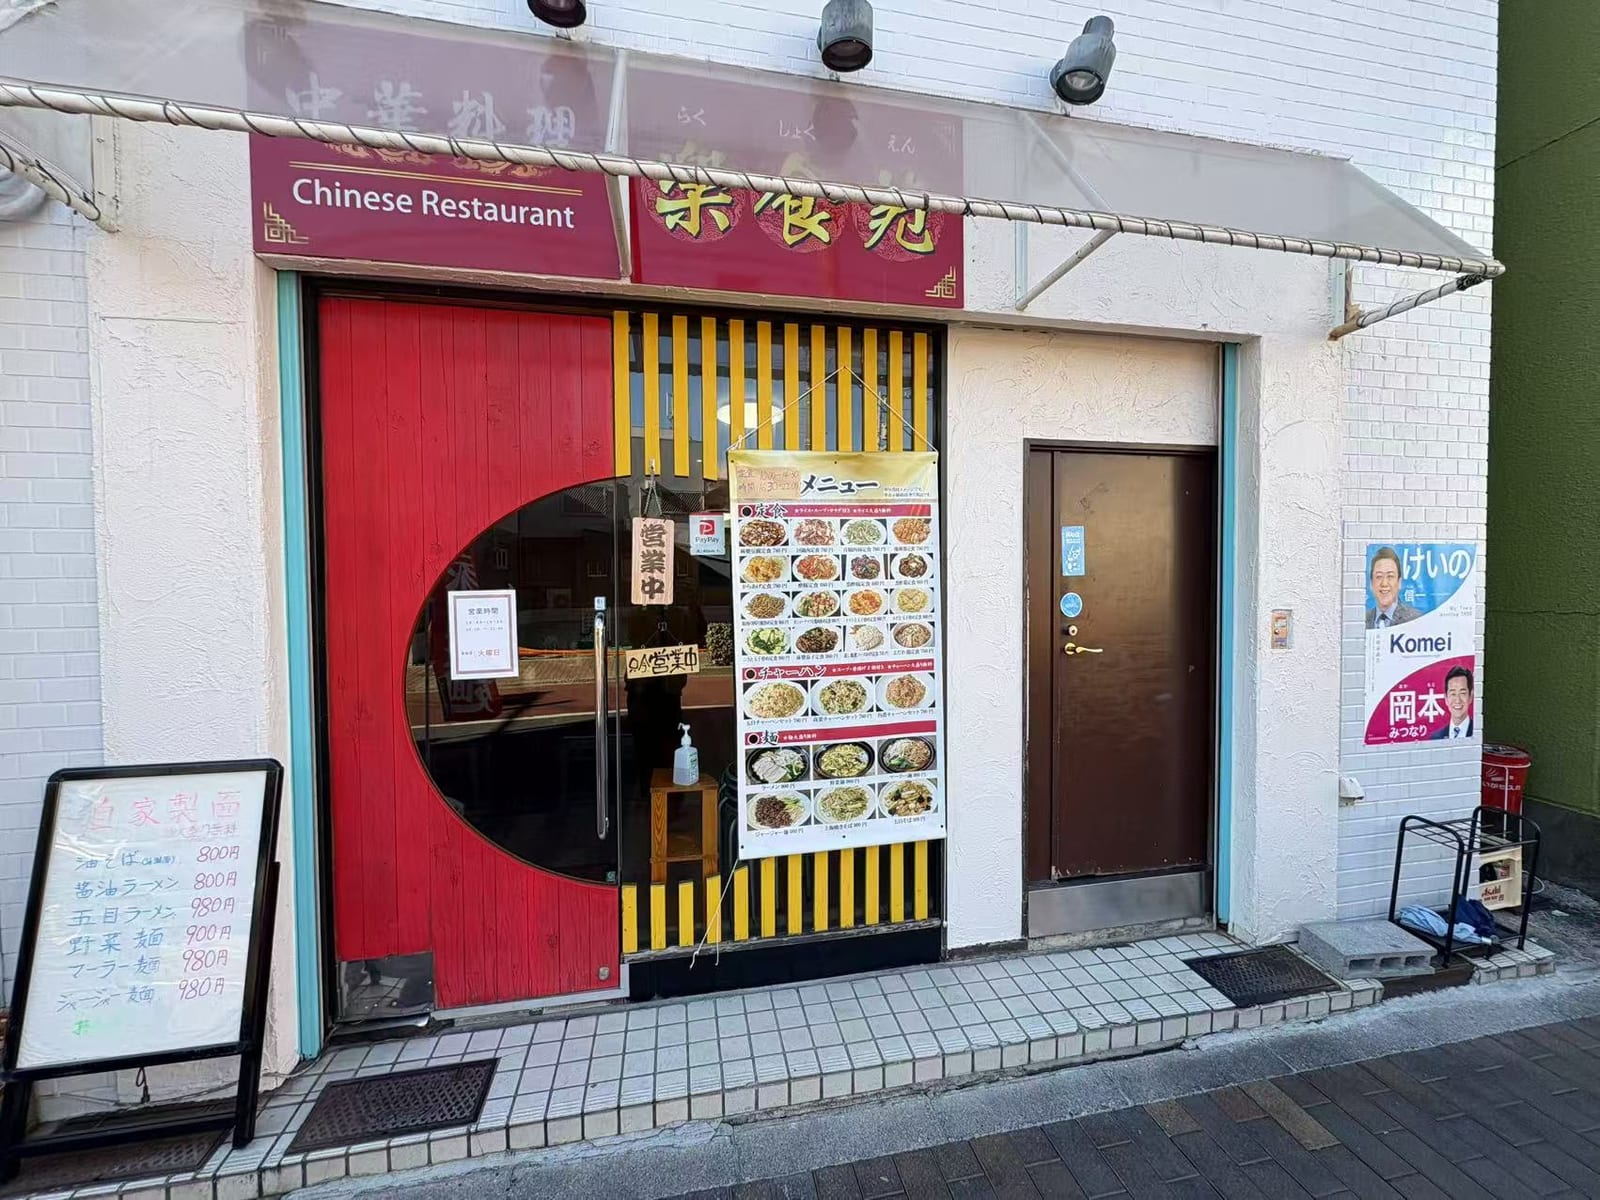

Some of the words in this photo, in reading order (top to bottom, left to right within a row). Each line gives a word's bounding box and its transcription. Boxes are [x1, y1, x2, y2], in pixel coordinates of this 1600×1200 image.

[285, 70, 576, 148] 中華料理
[676, 105, 707, 127] らく
[778, 119, 817, 141] しょく
[887, 134, 916, 155] えん
[292, 177, 413, 215] Chinese
[421, 189, 575, 229] Restaurant
[800, 474, 879, 494] メニュー
[756, 503, 788, 519] 定食
[640, 523, 667, 600] 営業中
[1402, 547, 1471, 580] けいの
[468, 607, 499, 615] 営業時間
[1390, 632, 1452, 654] Komei
[628, 647, 698, 675] 只今営業中
[758, 665, 827, 680] チャーハン
[1389, 688, 1445, 726] 岡本
[760, 730, 779, 745] 麺
[1388, 725, 1428, 739] みつなり
[196, 845, 240, 863] 800円
[193, 870, 238, 890] 800円
[1481, 885, 1501, 897] Asahi
[67, 905, 176, 928] 五目ラーメン
[190, 896, 235, 919] 980円
[67, 928, 164, 957] 野菜麺
[186, 924, 232, 946] 900円
[67, 956, 161, 980] マーラー麺
[182, 948, 228, 973] 980円
[178, 976, 225, 1001] 980円
